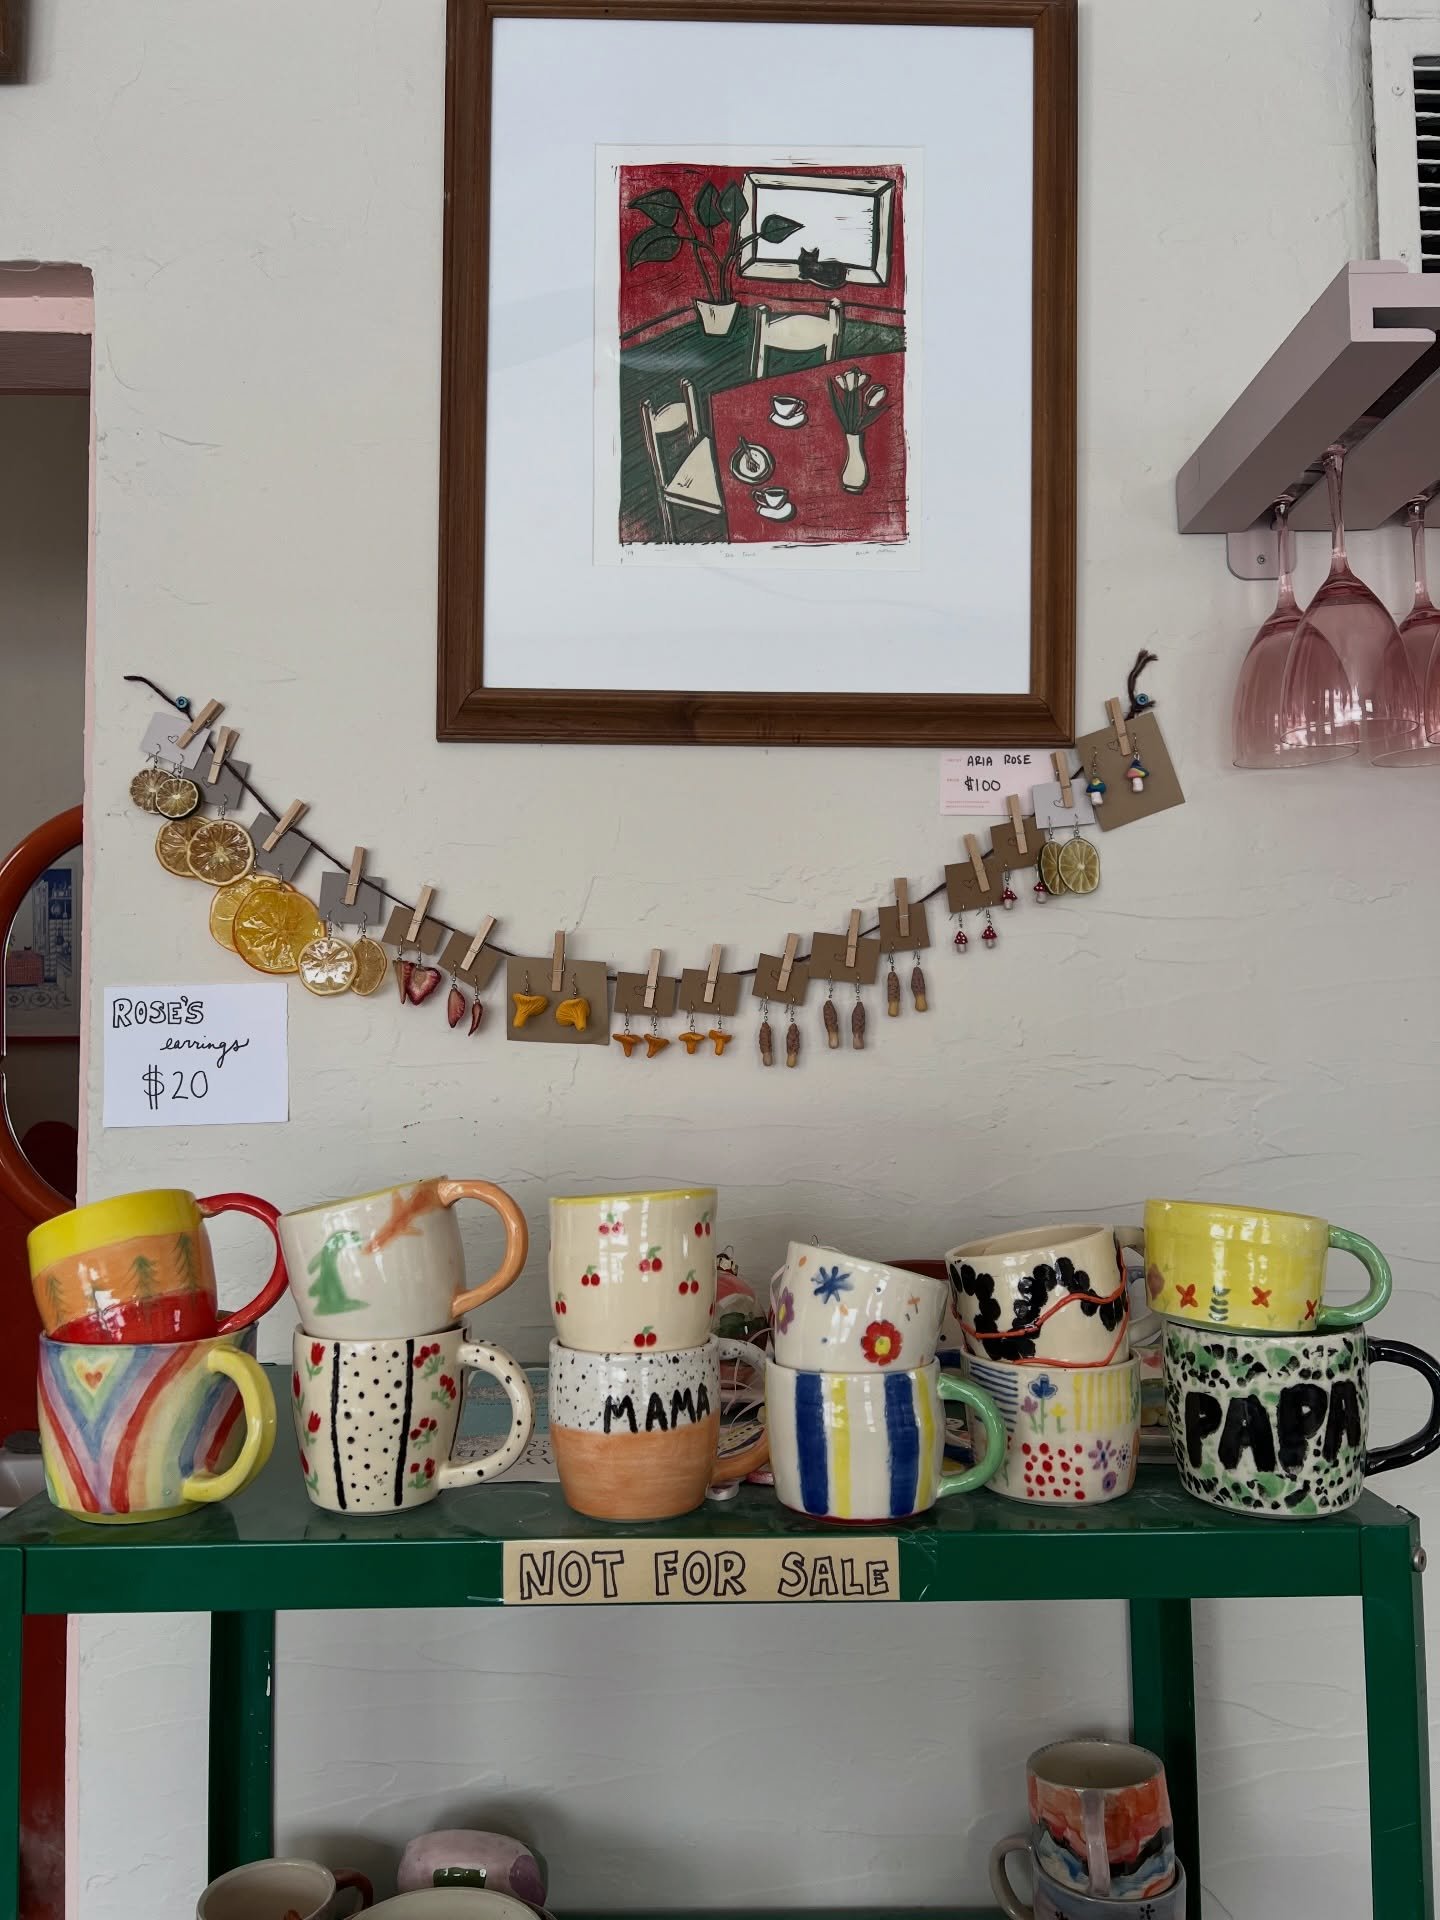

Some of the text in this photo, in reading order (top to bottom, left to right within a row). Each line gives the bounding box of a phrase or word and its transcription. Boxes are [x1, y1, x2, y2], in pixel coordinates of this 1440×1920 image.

[967, 755, 993, 767] ARIA
[1003, 754, 1032, 765] ROSE
[964, 776, 1001, 792] $100
[112, 995, 204, 1028] ROSE'S
[160, 1035, 250, 1069] earrings
[141, 1063, 209, 1110] $20
[603, 1382, 711, 1434] MAMA
[1184, 1379, 1362, 1475] PAPA
[519, 1550, 890, 1600] NOT FOR SALE
